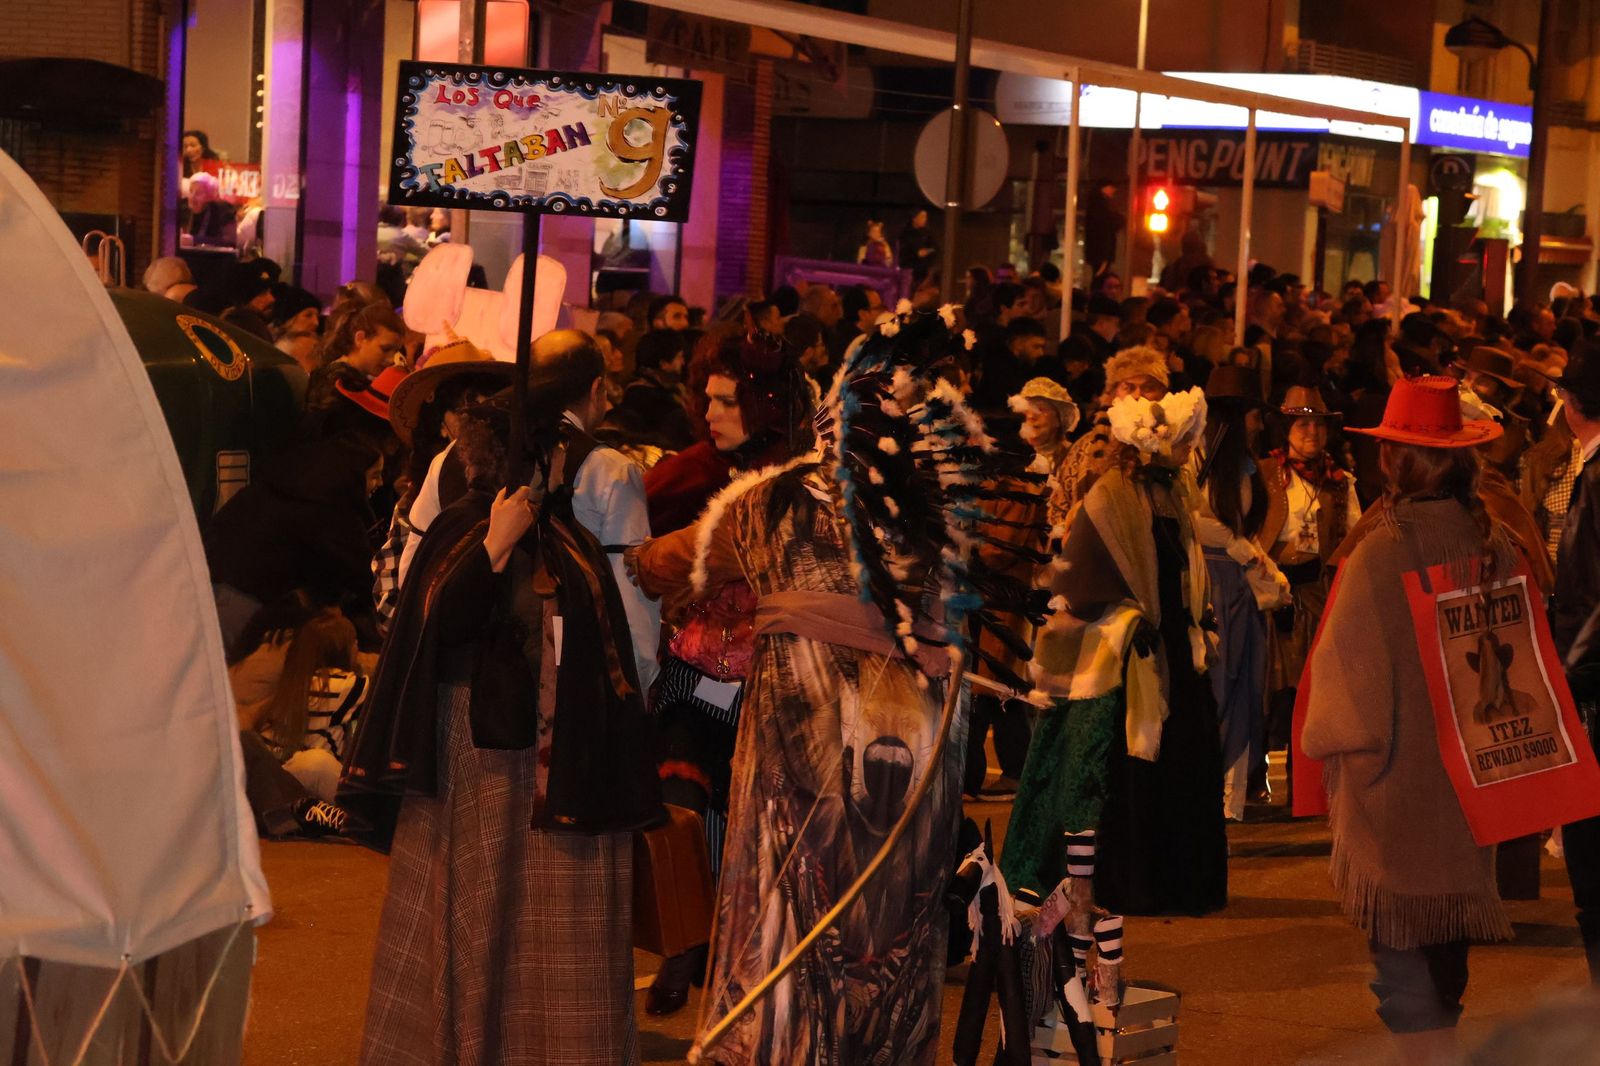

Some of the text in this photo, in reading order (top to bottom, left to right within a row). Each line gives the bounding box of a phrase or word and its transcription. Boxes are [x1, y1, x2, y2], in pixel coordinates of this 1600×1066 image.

[419, 122, 592, 191] FALTABAN
[1488, 717, 1533, 743] ITEZ
[1476, 736, 1558, 771] REWARD $9000
